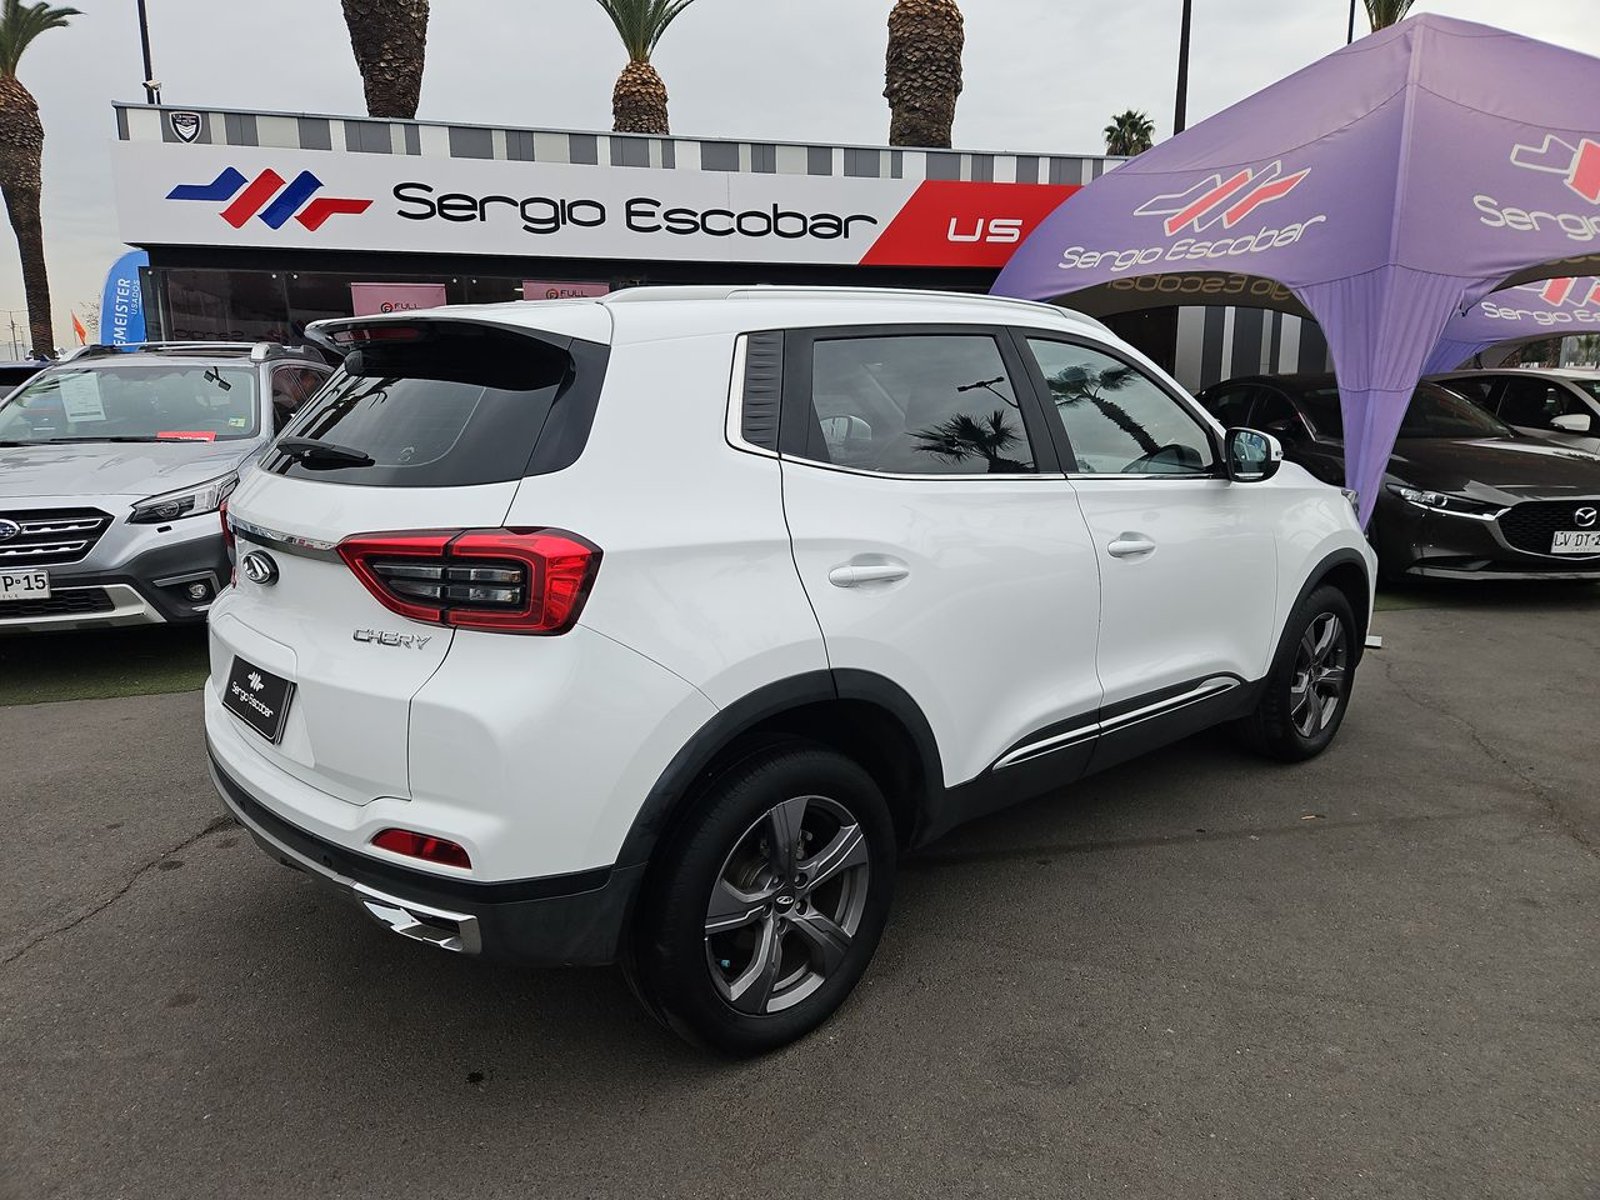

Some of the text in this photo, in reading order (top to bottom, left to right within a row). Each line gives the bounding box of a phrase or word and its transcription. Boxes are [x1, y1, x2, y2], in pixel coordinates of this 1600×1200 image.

[393, 182, 878, 240] Sergio Escobar
[947, 217, 1023, 243] US
[1058, 215, 1327, 272] Sergio Escobar
[131, 280, 140, 315] USADOS
[1481, 301, 1573, 326] Sergio
[353, 628, 432, 650] CHERY
[231, 681, 274, 718] Sergio Escobar
